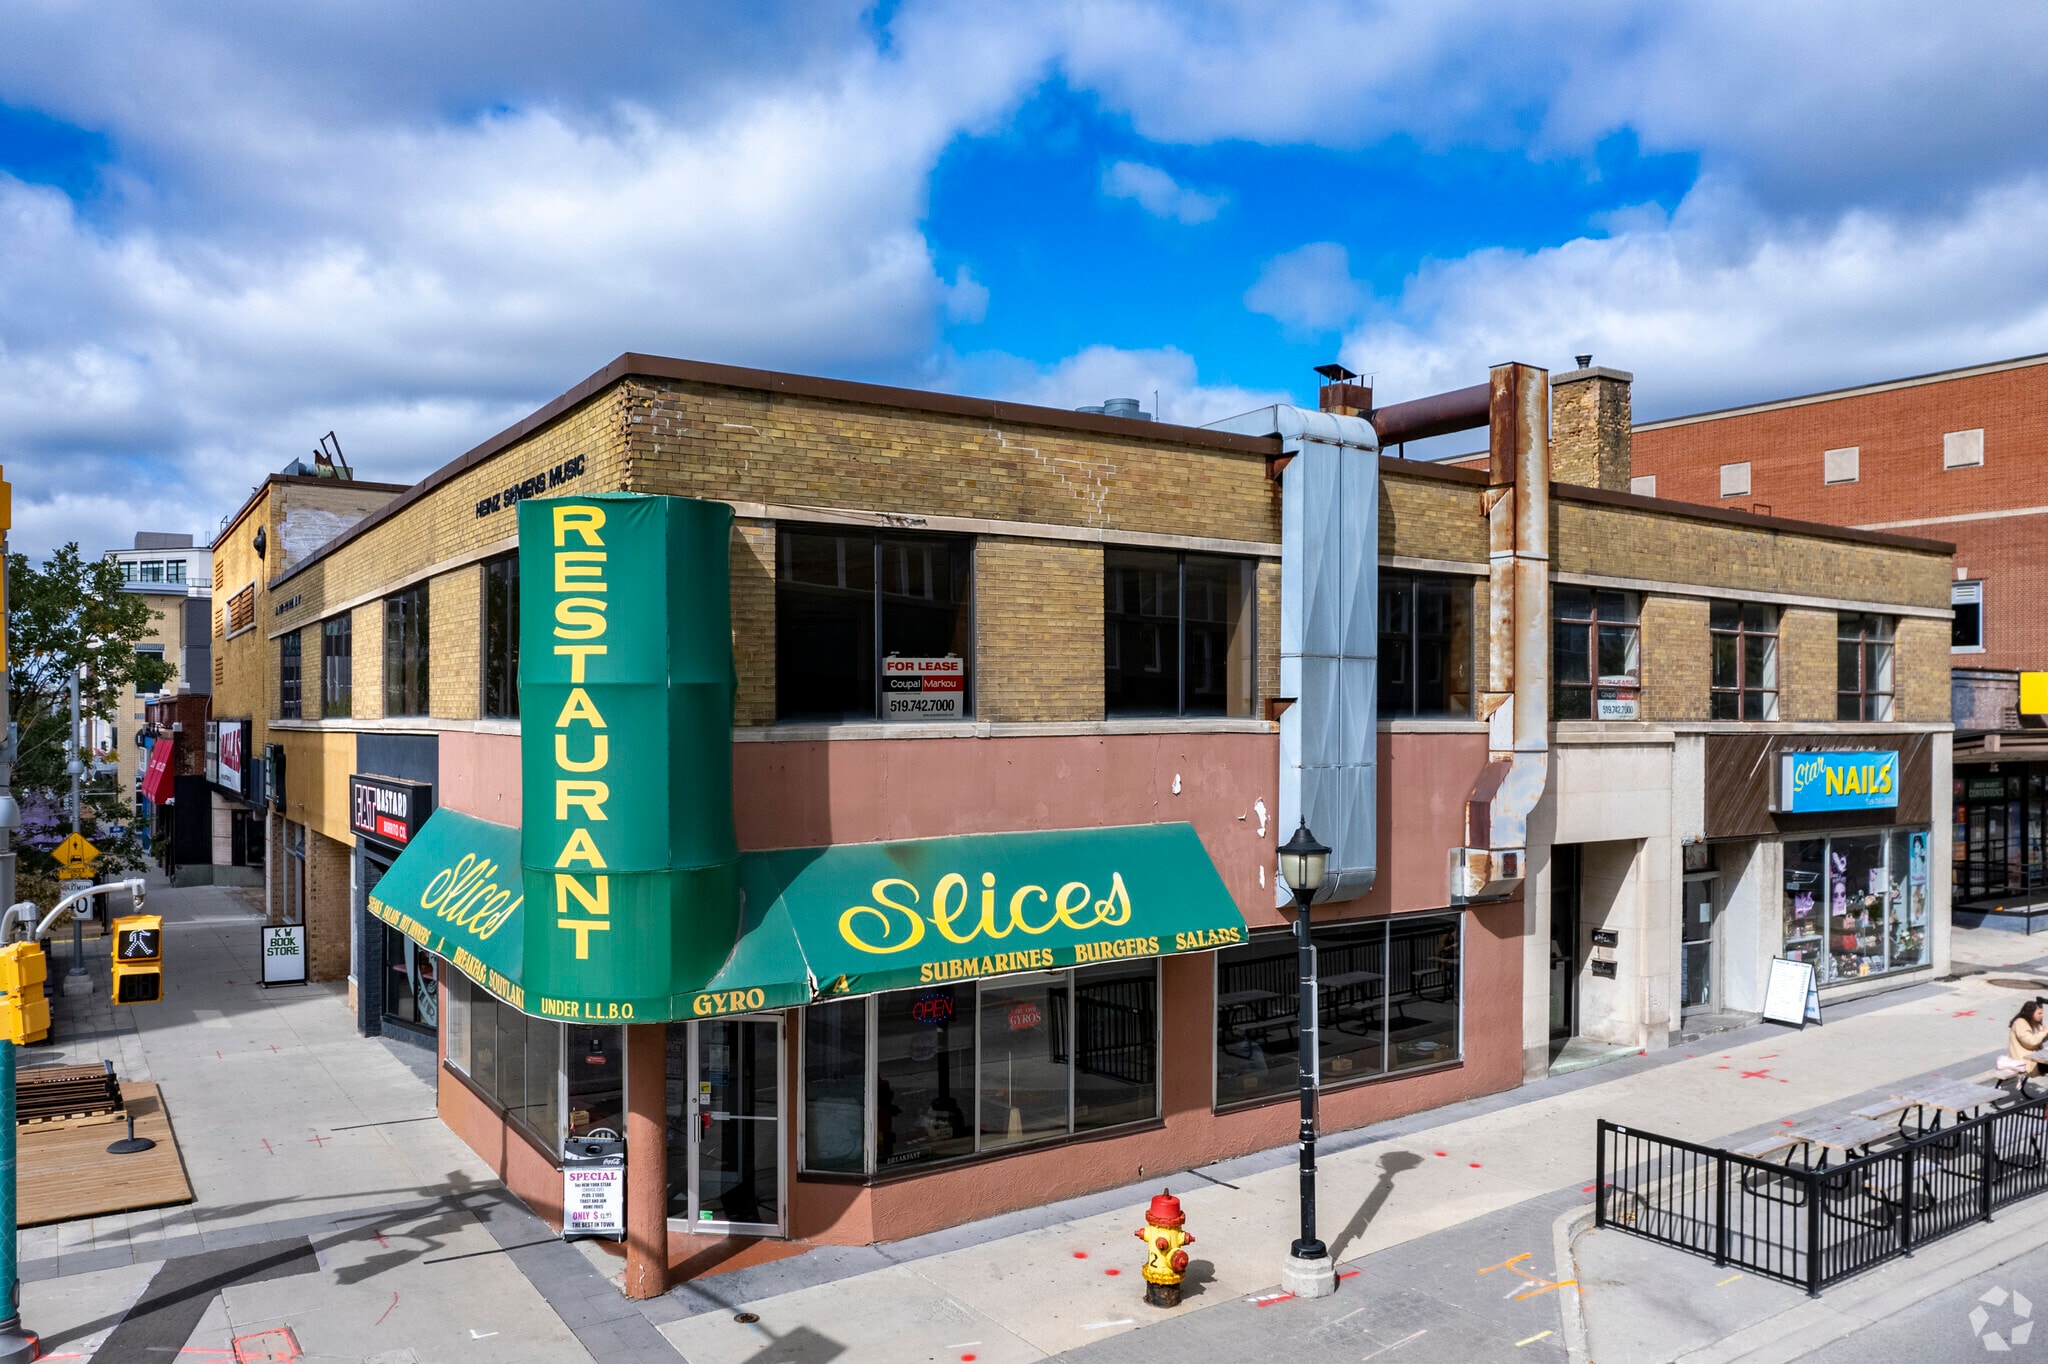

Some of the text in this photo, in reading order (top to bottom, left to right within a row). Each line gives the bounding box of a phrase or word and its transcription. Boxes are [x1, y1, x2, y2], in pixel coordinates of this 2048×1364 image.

[475, 454, 585, 519] HEINZ SIEMENS MUSIC
[887, 662, 958, 671] FOR LEASE
[890, 680, 956, 690] Coupal Markou
[890, 699, 955, 712] 519.742.7000
[553, 505, 610, 959] RESTAURANT
[1793, 757, 1827, 792] Star
[1825, 765, 1892, 796] NAILS
[354, 784, 377, 832] FAT
[376, 788, 407, 818] BASTARD
[383, 820, 408, 840] BURRITO CO.
[421, 853, 524, 940] Slices
[838, 872, 1131, 953] Slices
[270, 937, 296, 947] BOOK
[274, 928, 292, 937] K W
[266, 946, 300, 956] STORE
[920, 927, 1241, 982] SUBMARINES BURGERS SALADS
[488, 968, 525, 1009] SOUVLAKI
[541, 997, 635, 1019] UNDER L.L.B.O.
[693, 988, 765, 1016] GYRO
[911, 997, 955, 1020] OPEN
[1010, 1012, 1042, 1025] GYROS
[886, 1151, 921, 1165] BREAKFAST
[569, 1172, 617, 1181] SPECIAL
[572, 1211, 590, 1220] ONLY
[593, 1211, 598, 1220] $
